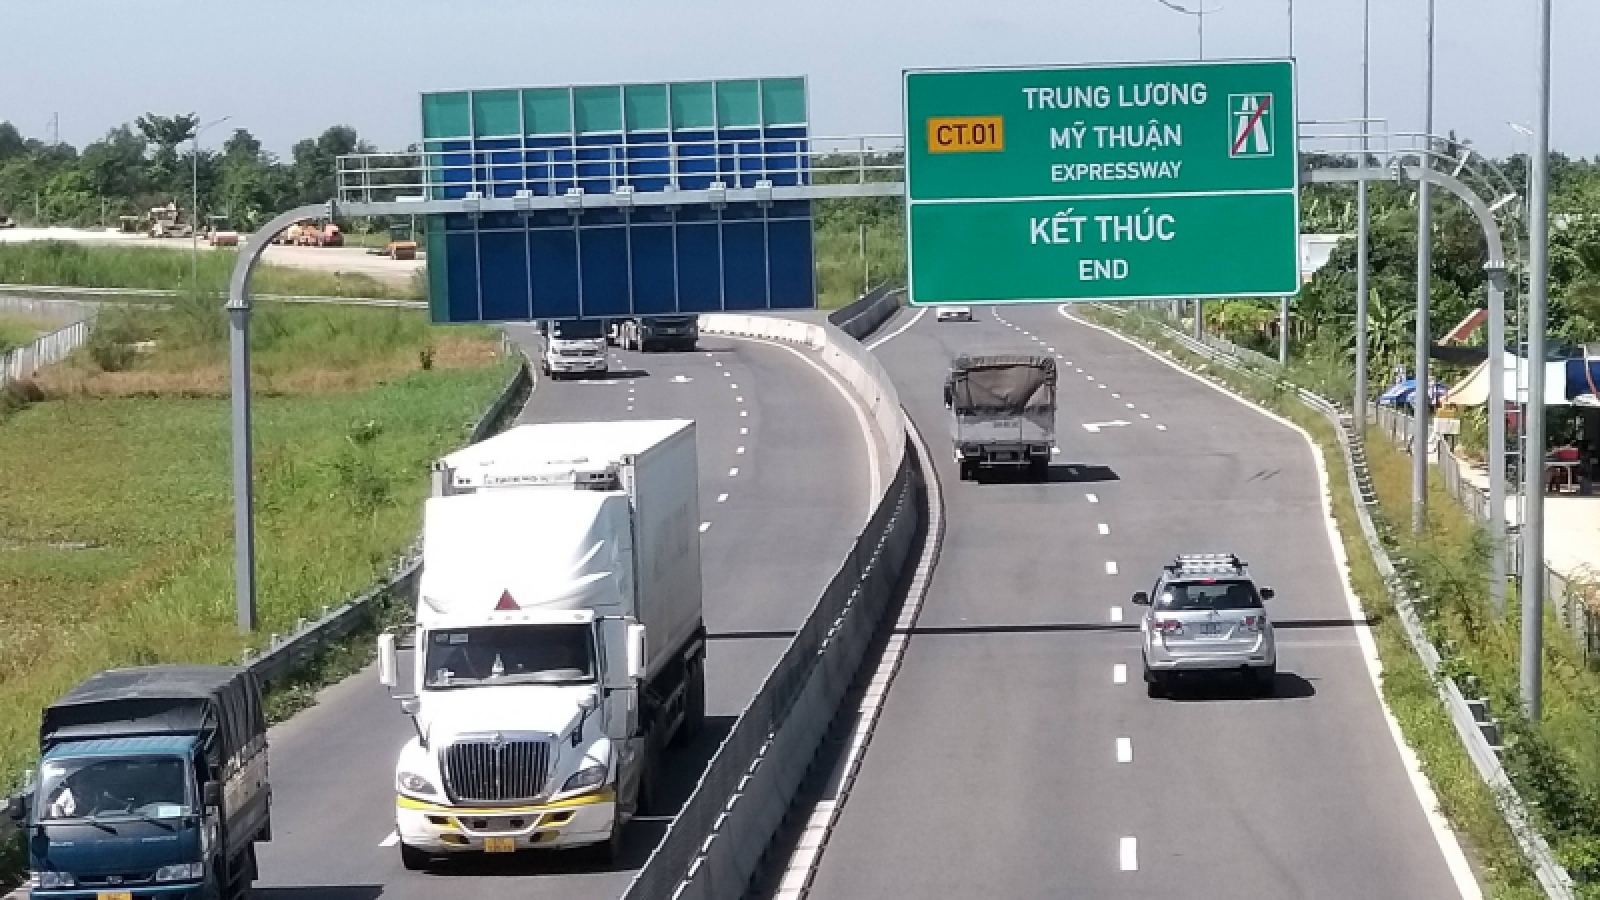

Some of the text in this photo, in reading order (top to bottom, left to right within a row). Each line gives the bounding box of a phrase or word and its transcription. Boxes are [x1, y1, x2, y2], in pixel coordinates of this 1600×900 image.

[1022, 81, 1208, 109] TRUNG LƯƠNG
[937, 123, 997, 146] CT.01
[1050, 119, 1182, 151] MỸ THUẬN
[1051, 160, 1182, 182] EXPRESSWAY
[1030, 206, 1176, 244] KẾT THÚC
[1079, 259, 1128, 281] END
